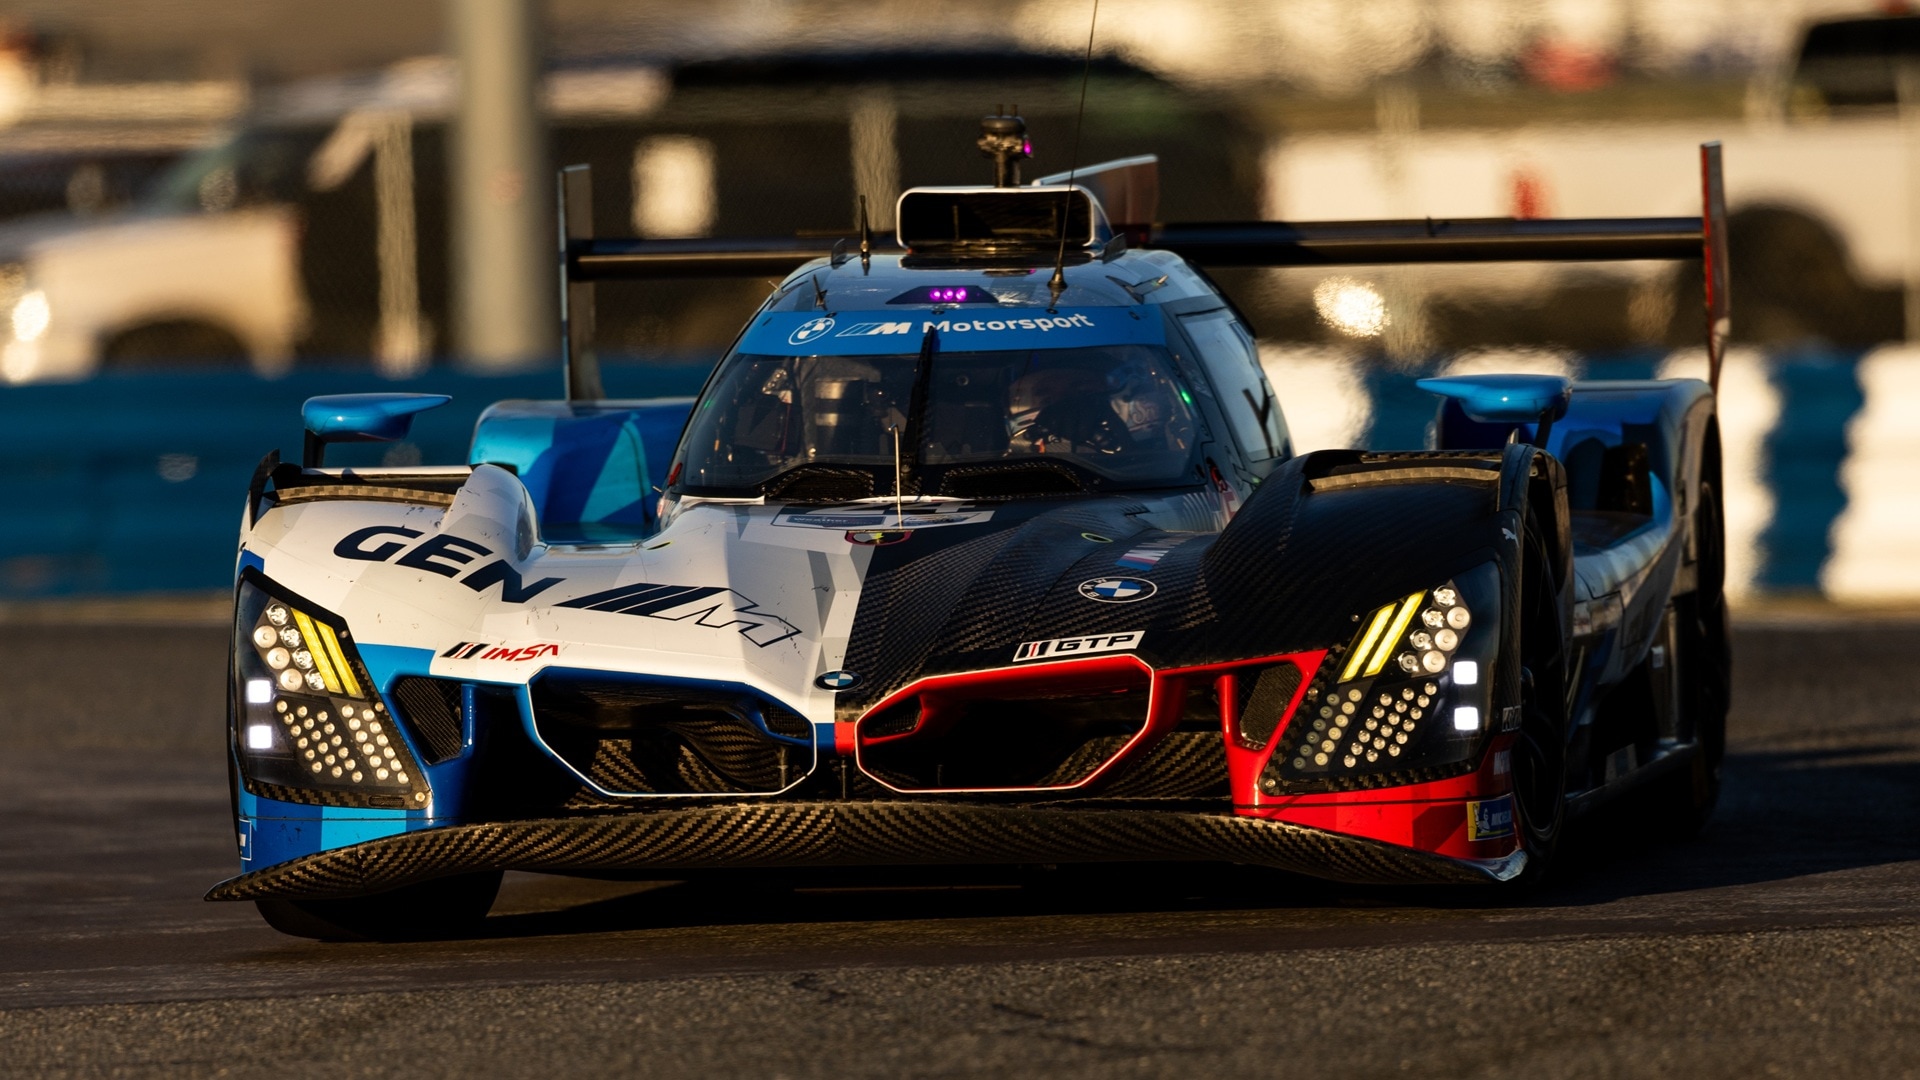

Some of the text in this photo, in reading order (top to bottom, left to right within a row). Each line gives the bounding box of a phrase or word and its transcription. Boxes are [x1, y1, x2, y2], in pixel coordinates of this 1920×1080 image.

[922, 313, 1095, 333] Motorsport
[333, 526, 567, 604] GEN
[480, 644, 559, 662] IMSA
[1055, 635, 1135, 652] GTP
